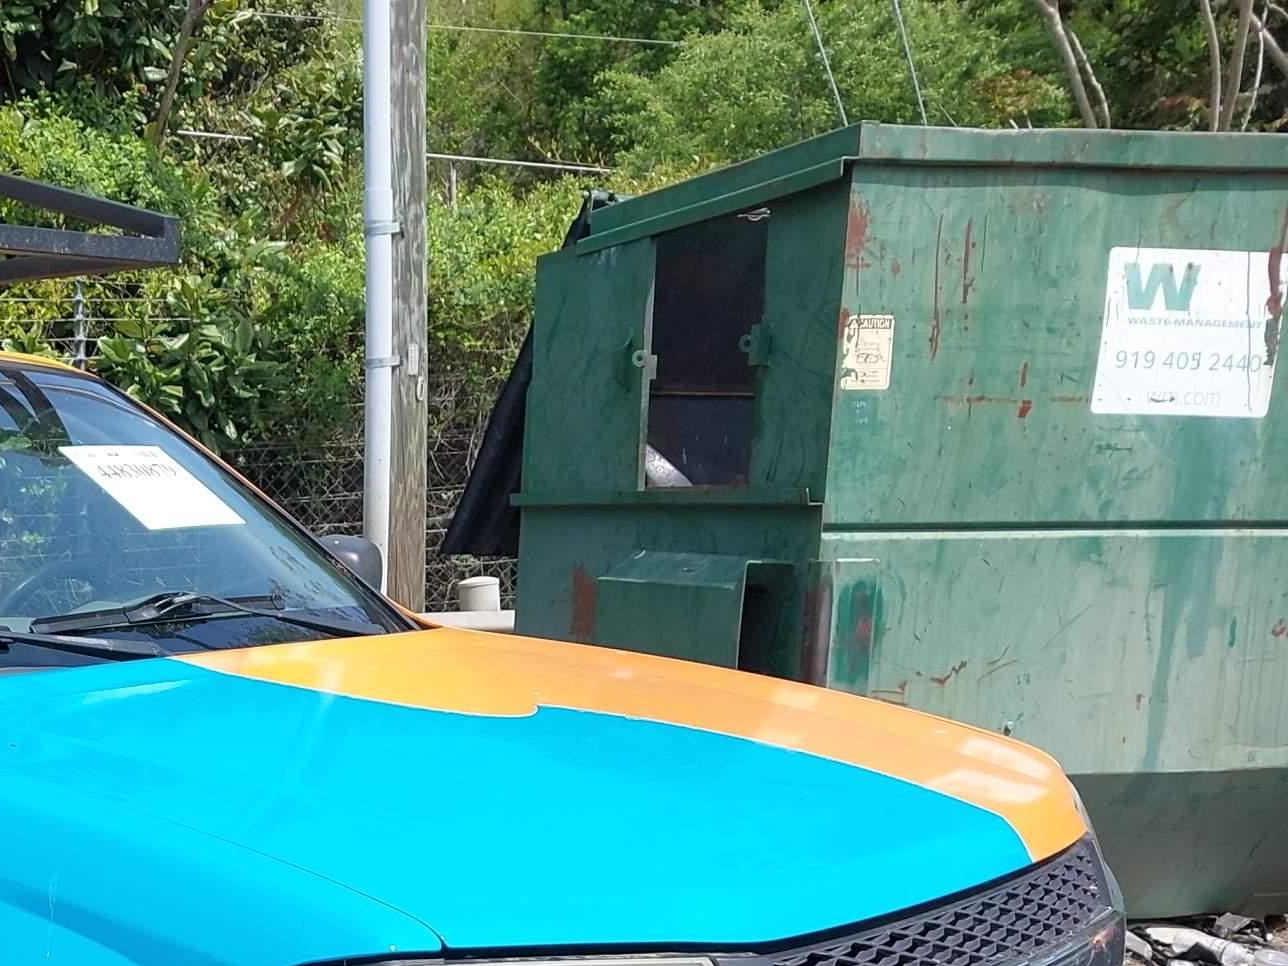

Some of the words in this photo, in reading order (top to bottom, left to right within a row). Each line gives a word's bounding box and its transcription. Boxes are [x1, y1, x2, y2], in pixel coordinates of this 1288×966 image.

[1174, 318, 1262, 330] MANAGEMENT
[1115, 350, 1156, 369] 919
[1161, 351, 1202, 371] 405
[1208, 352, 1263, 373] 2440
